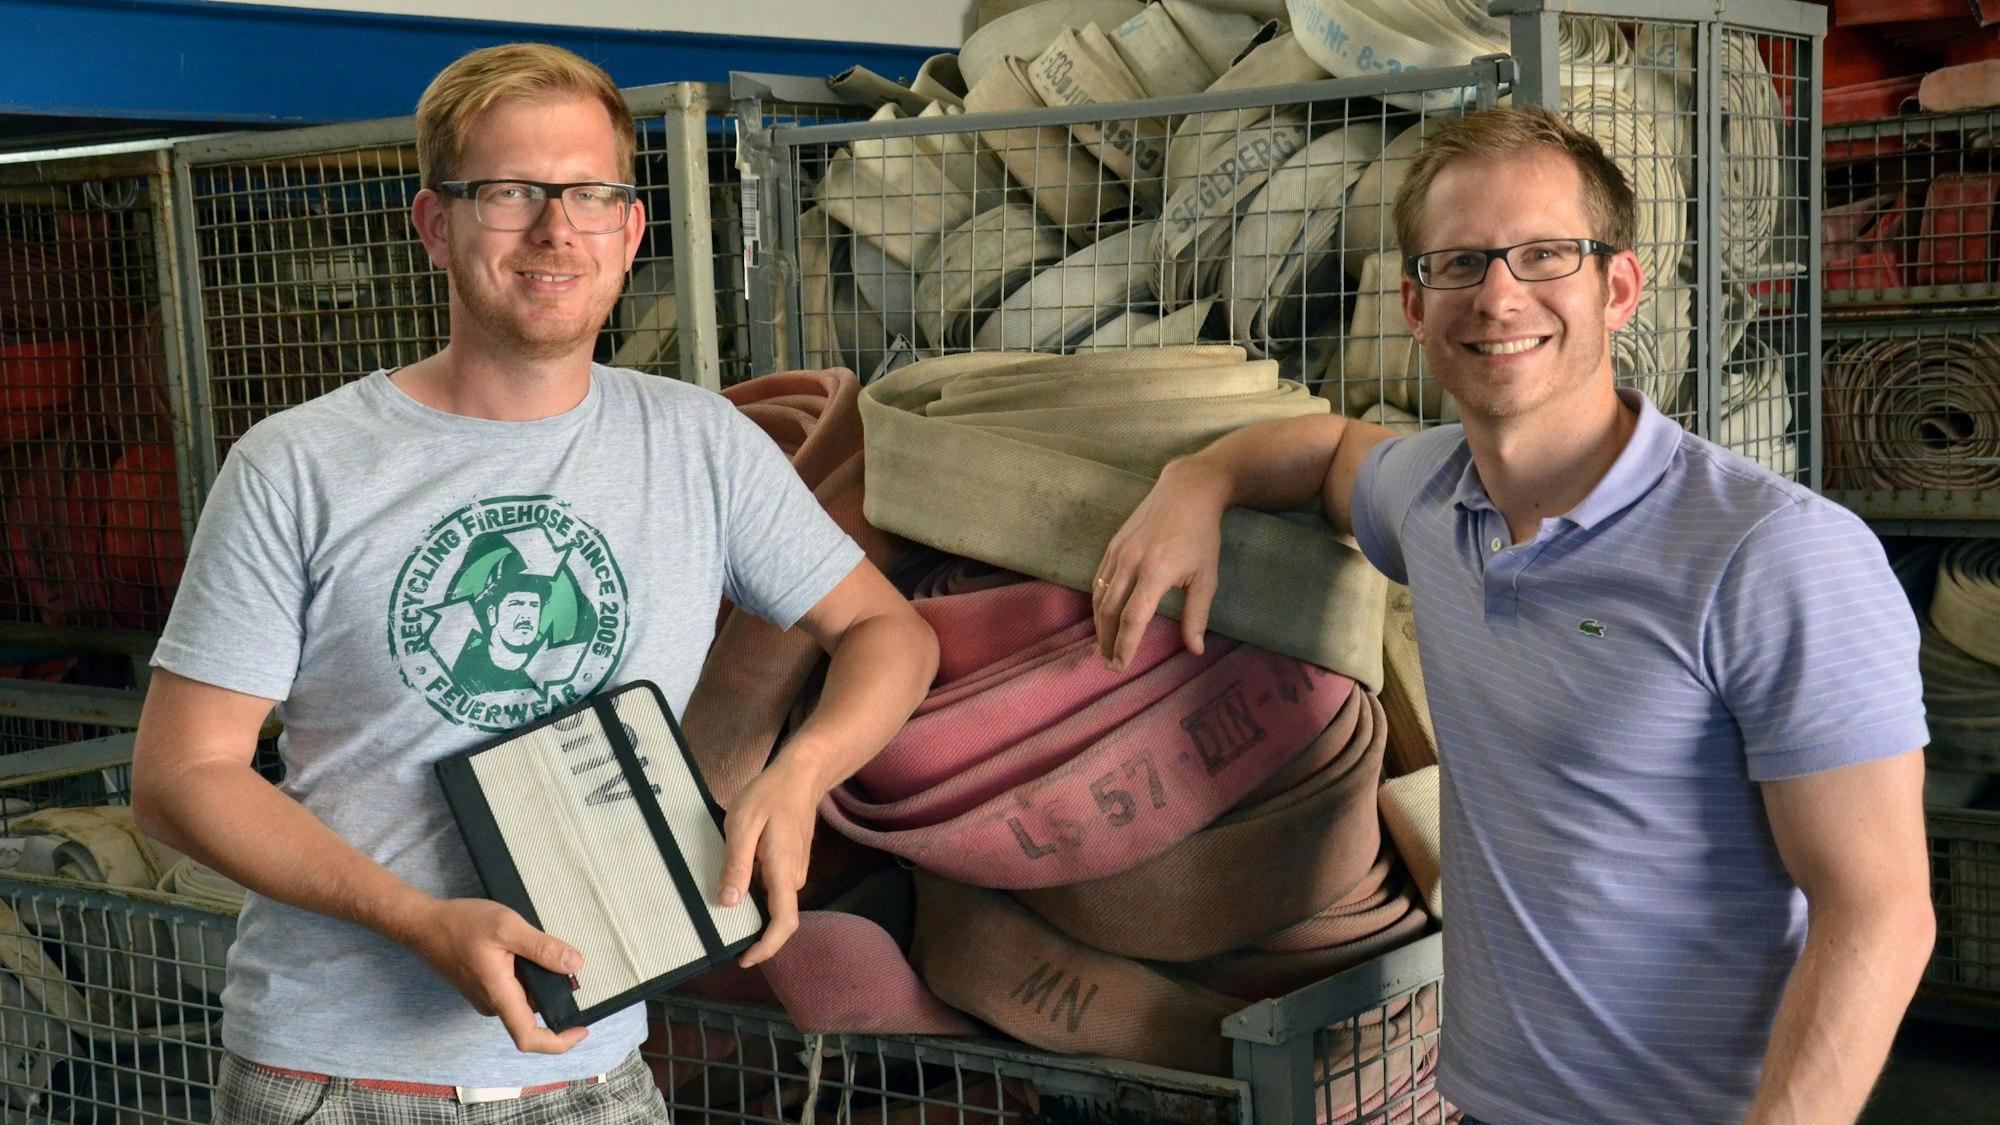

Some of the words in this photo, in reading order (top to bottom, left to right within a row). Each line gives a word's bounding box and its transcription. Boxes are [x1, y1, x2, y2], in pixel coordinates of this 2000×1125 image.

[1172, 130, 1296, 233] SEGEBERG
[401, 528, 461, 656] RECYCLING
[568, 530, 617, 596] SINCE
[591, 601, 619, 658] 2005
[425, 676, 581, 724] FEUERWEAR
[1089, 757, 1167, 827] 57
[1008, 962, 1100, 1034] MN
